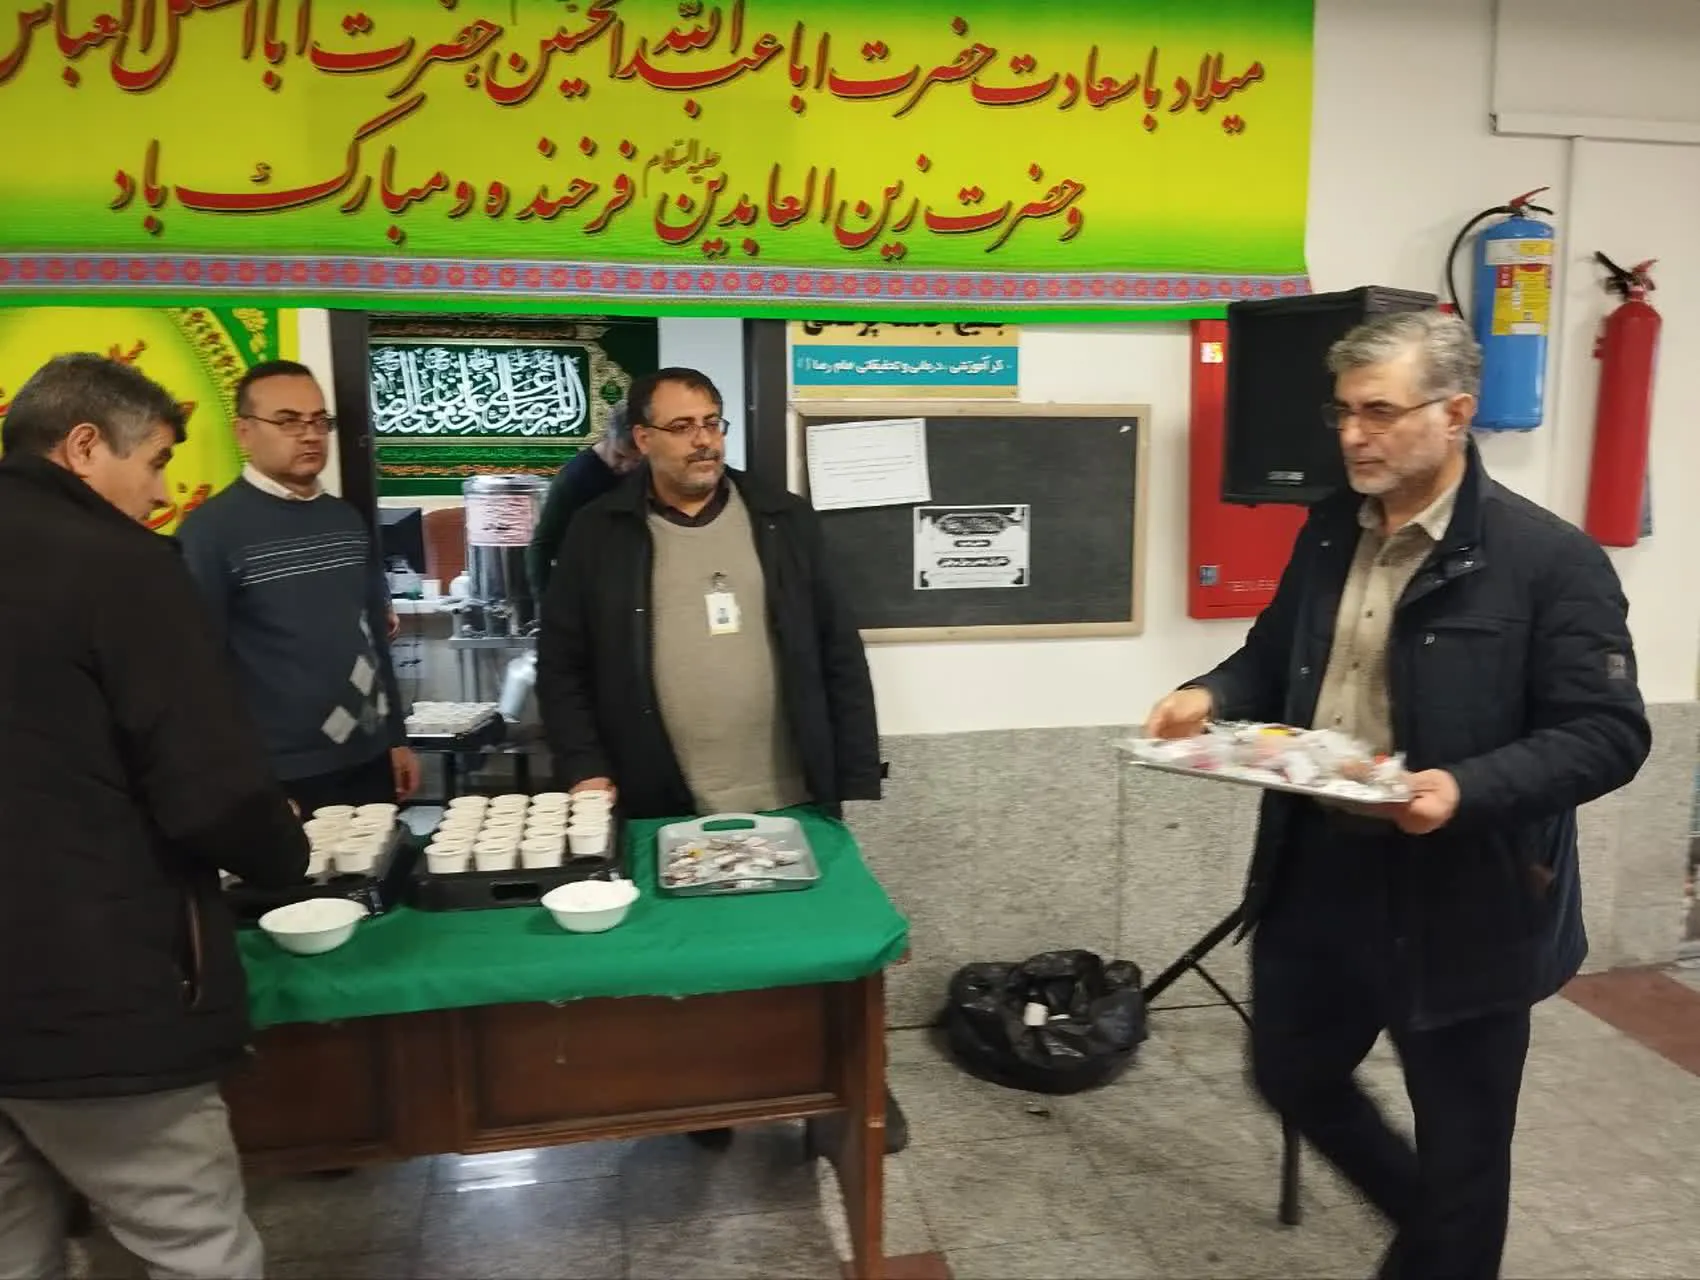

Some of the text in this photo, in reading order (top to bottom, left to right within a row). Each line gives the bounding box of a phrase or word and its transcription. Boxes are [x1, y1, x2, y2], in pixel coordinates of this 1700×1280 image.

[309, 0, 496, 98] حضرت
[829, 17, 997, 117] حضرت
[1168, 52, 1265, 134] میلاد
[110, 139, 167, 235] باد
[484, 138, 638, 234] فرخنده
[654, 163, 836, 260] العابدین
[833, 154, 931, 260] زین
[924, 163, 1087, 253] حضرت
